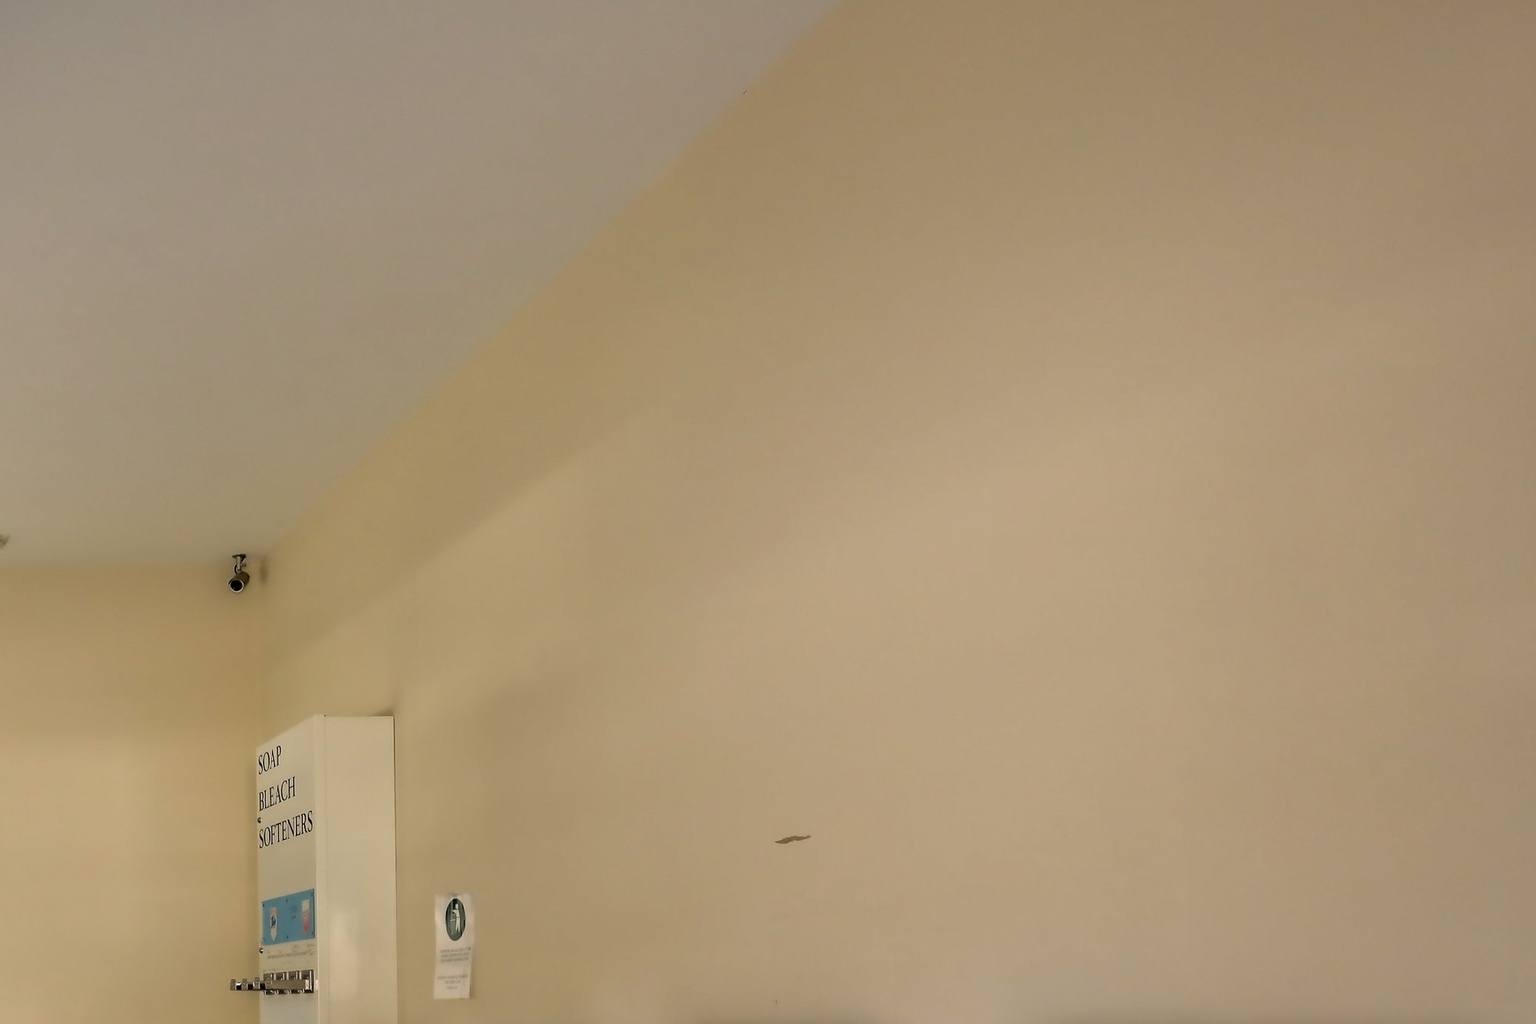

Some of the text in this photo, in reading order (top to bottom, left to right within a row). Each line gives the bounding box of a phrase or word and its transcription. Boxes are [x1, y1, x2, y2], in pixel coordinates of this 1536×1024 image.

[258, 745, 282, 775] SOAP
[258, 776, 296, 811] BLEACH
[258, 810, 314, 849] SOFTENERS
